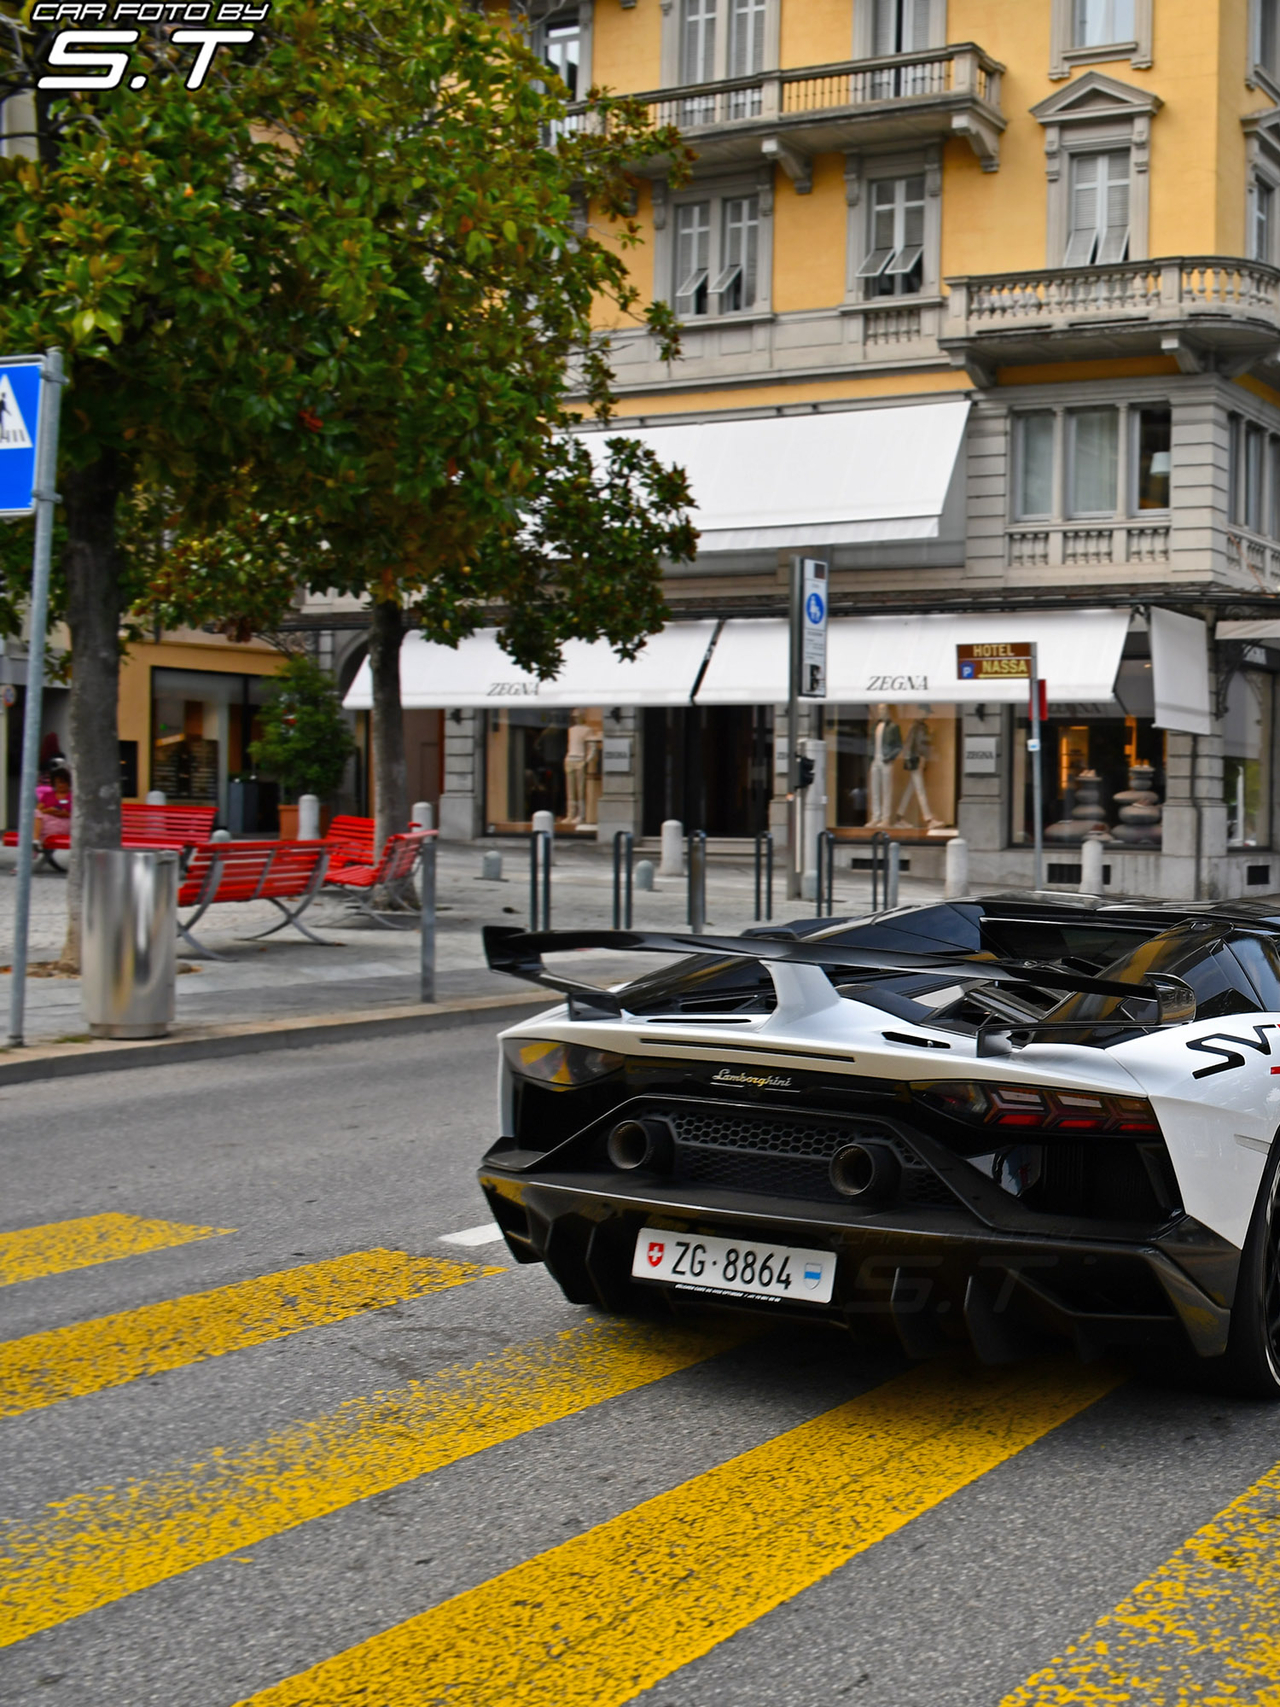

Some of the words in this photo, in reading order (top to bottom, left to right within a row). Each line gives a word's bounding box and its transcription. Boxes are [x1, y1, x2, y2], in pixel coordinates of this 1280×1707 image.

[973, 644, 1015, 657] HOTEL
[982, 660, 1028, 673] NASSA
[486, 682, 540, 697] ZEGNA
[866, 675, 929, 691] ZEGNA
[712, 1068, 793, 1087] Lamborghini
